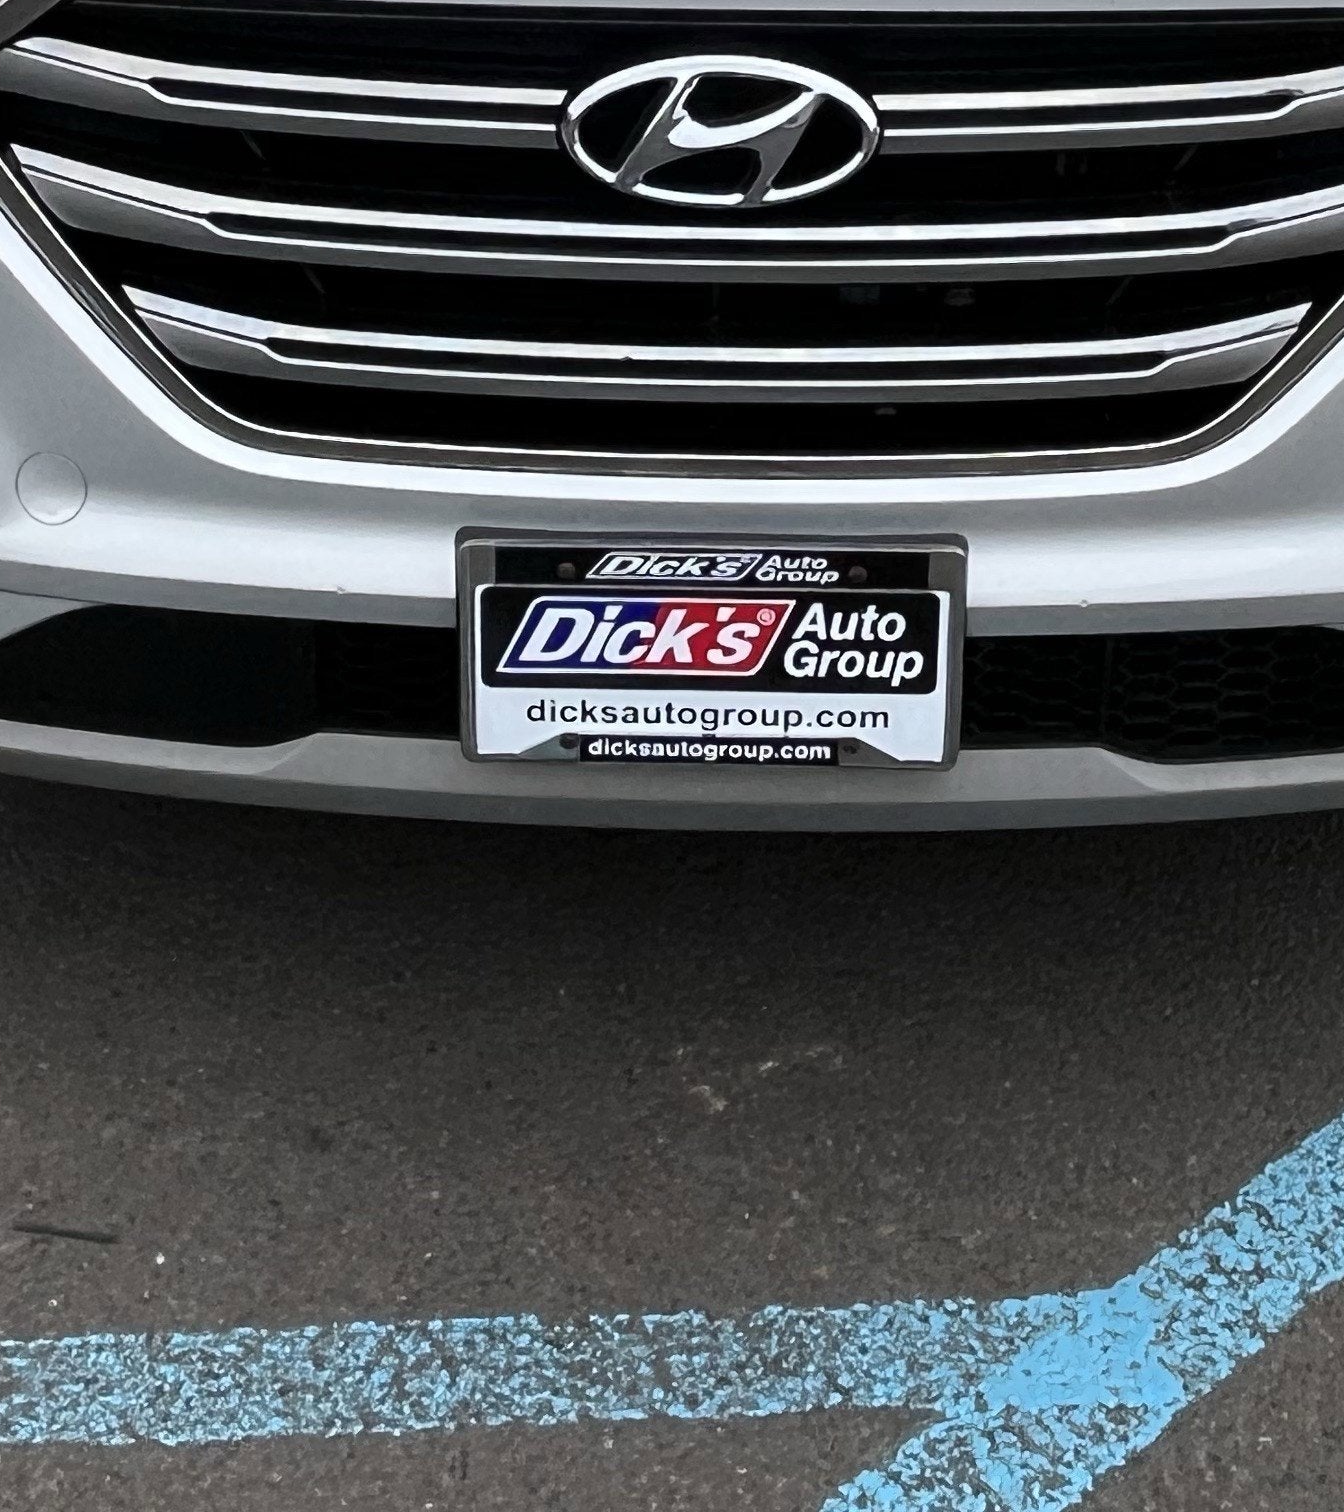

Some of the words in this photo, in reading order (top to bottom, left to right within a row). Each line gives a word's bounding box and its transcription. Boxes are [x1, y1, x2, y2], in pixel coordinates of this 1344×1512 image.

[755, 568, 840, 585] Group
[764, 554, 828, 570] Auto
[517, 604, 762, 666] Dick's
[791, 602, 908, 642] Auto
[783, 643, 925, 687] Group
[526, 699, 891, 733] dicksautogroup.com
